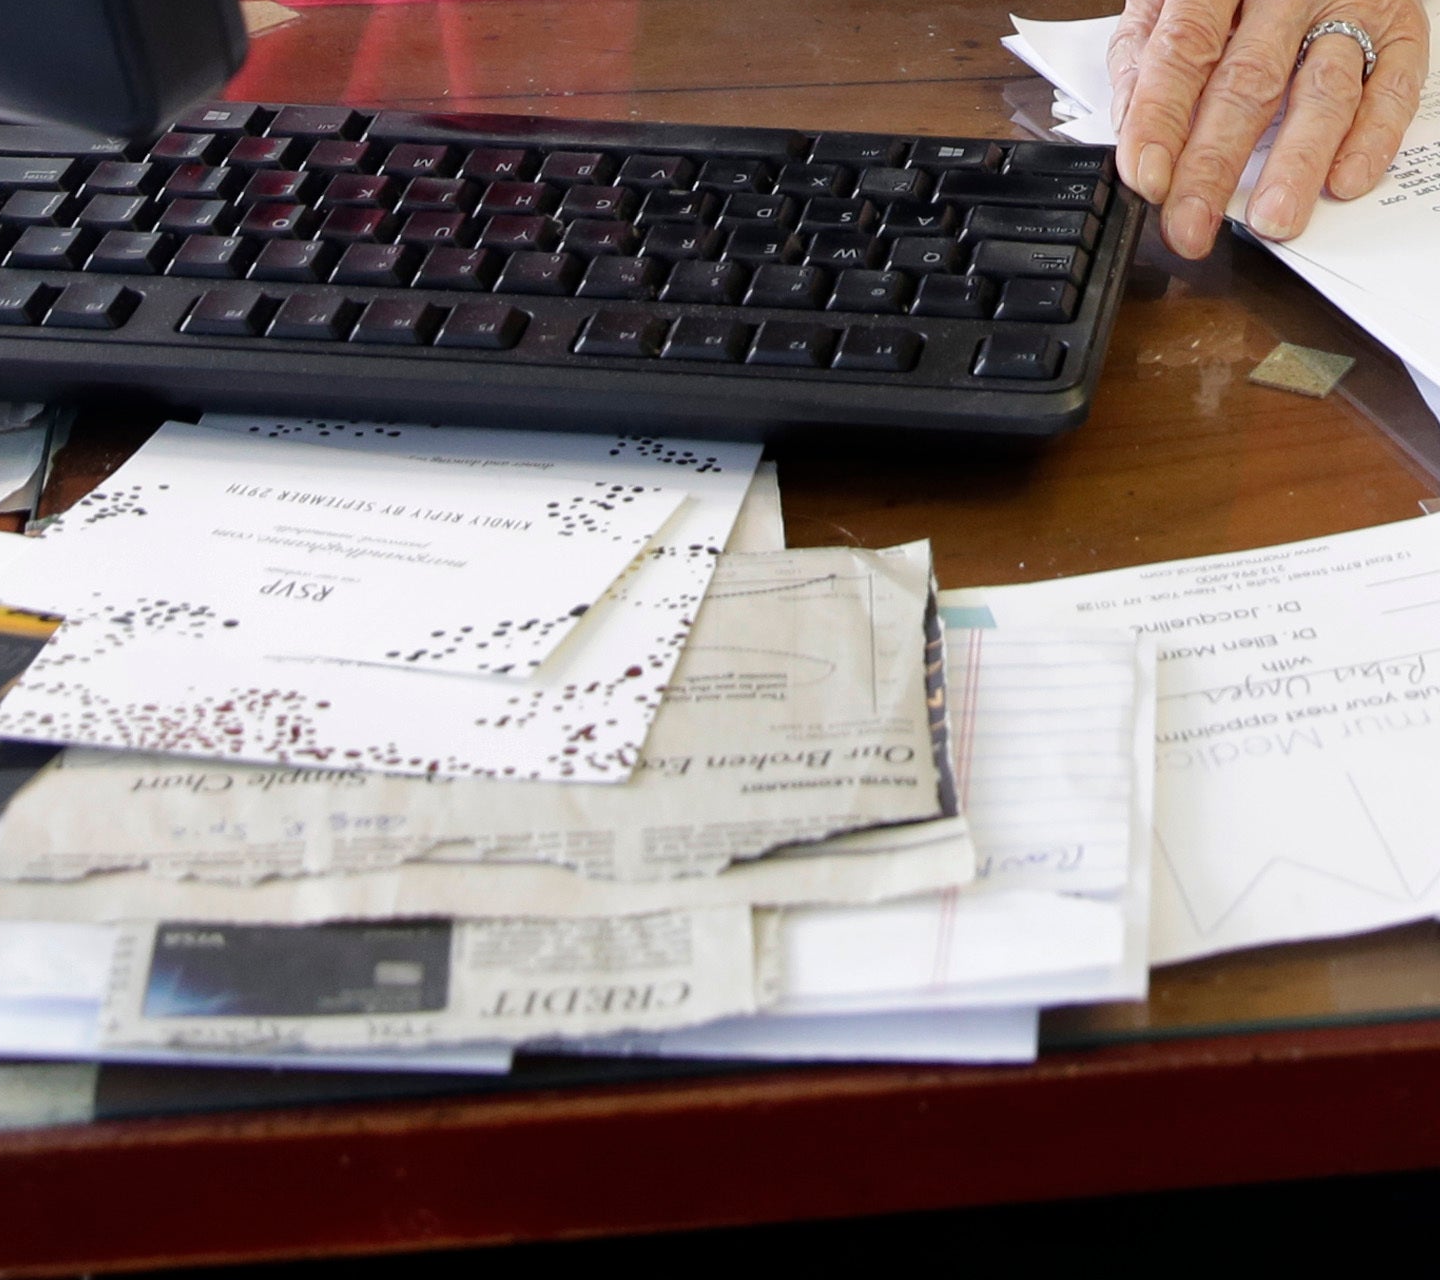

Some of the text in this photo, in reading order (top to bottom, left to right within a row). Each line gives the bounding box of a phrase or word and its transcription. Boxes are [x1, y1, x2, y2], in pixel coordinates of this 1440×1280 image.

[225, 482, 274, 499] 29TH
[277, 490, 374, 514] SEPTEMBER
[411, 507, 464, 524] REPLY
[467, 514, 533, 532] KINDLY
[259, 578, 336, 602] RSVP
[1127, 606, 1260, 638] Jacqueline
[1221, 631, 1278, 656] Ellen
[1261, 655, 1313, 676] with
[1284, 701, 1339, 724] next
[1343, 688, 1396, 715] your
[1153, 712, 1280, 745] appointm
[131, 741, 916, 800] Our Broken Simple Chart
[477, 978, 693, 1019] CREDIT
